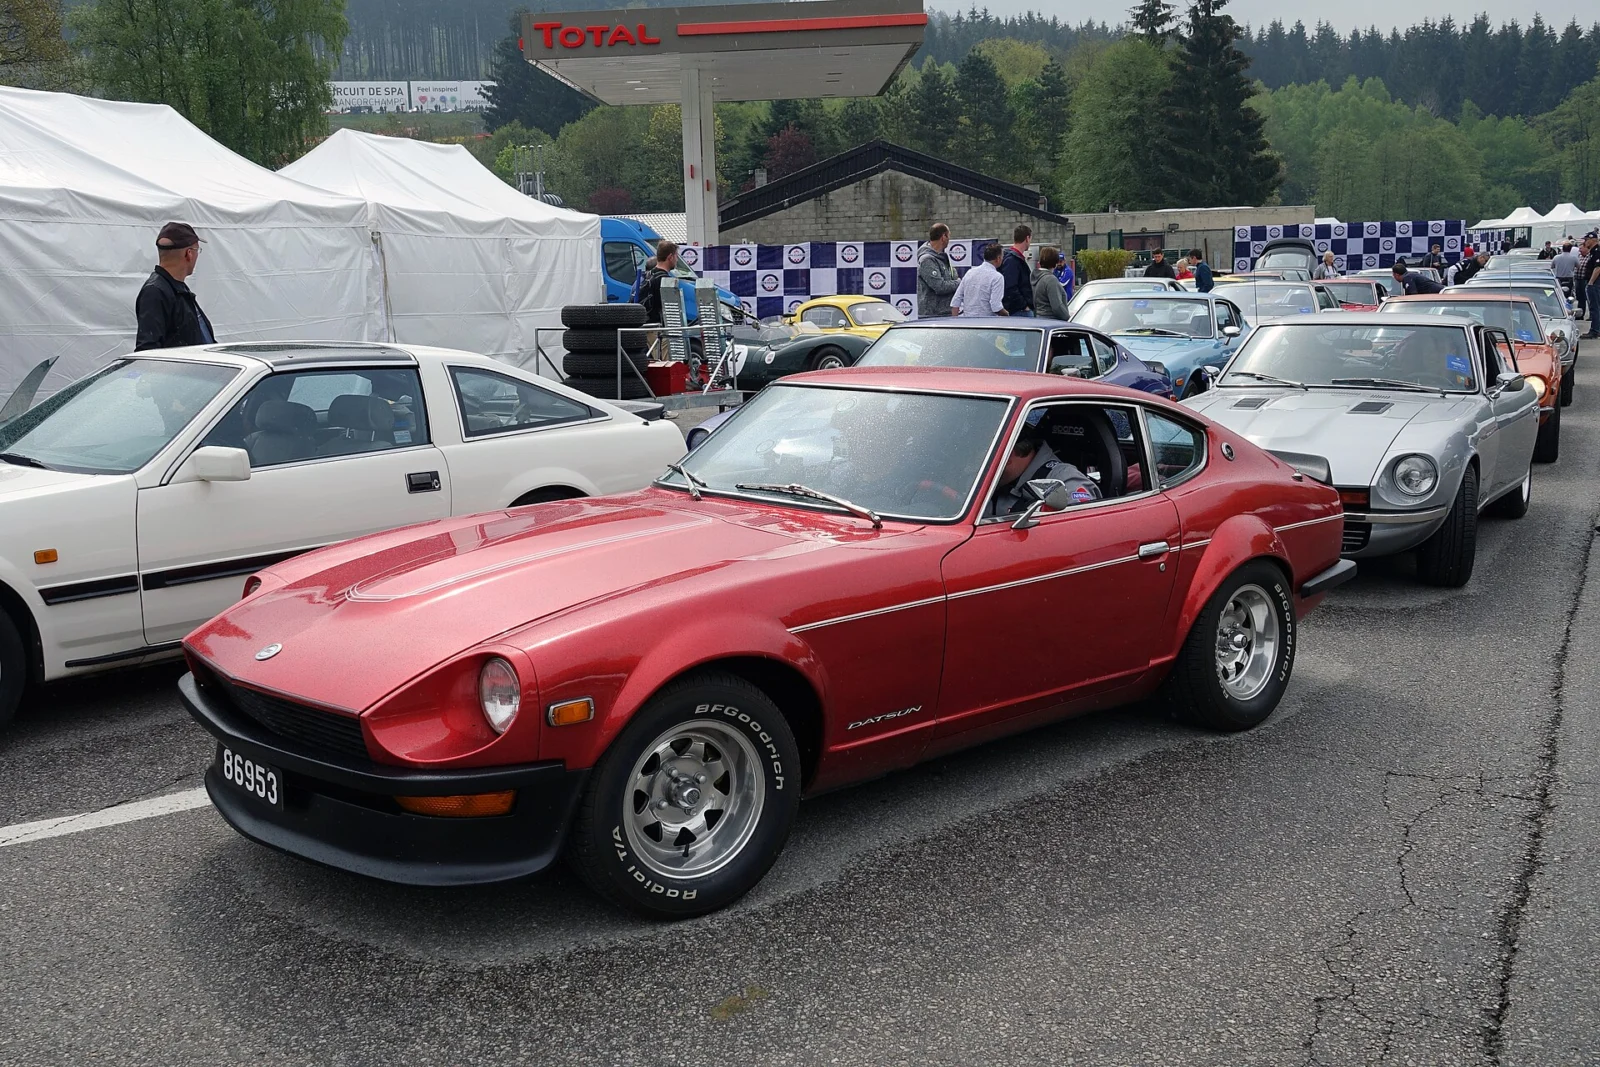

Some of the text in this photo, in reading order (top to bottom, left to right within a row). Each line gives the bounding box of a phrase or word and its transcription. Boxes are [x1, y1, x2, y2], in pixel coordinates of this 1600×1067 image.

[533, 22, 661, 49] TOTAL
[332, 87, 404, 96] IRCUIT DE SPA
[1052, 425, 1085, 435] sparco
[1274, 583, 1294, 682] BFGoodrich
[847, 705, 922, 730] DATSUN
[695, 704, 785, 790] BFGoodrich
[223, 749, 278, 804] 86953
[612, 826, 698, 900] Radial T/A
